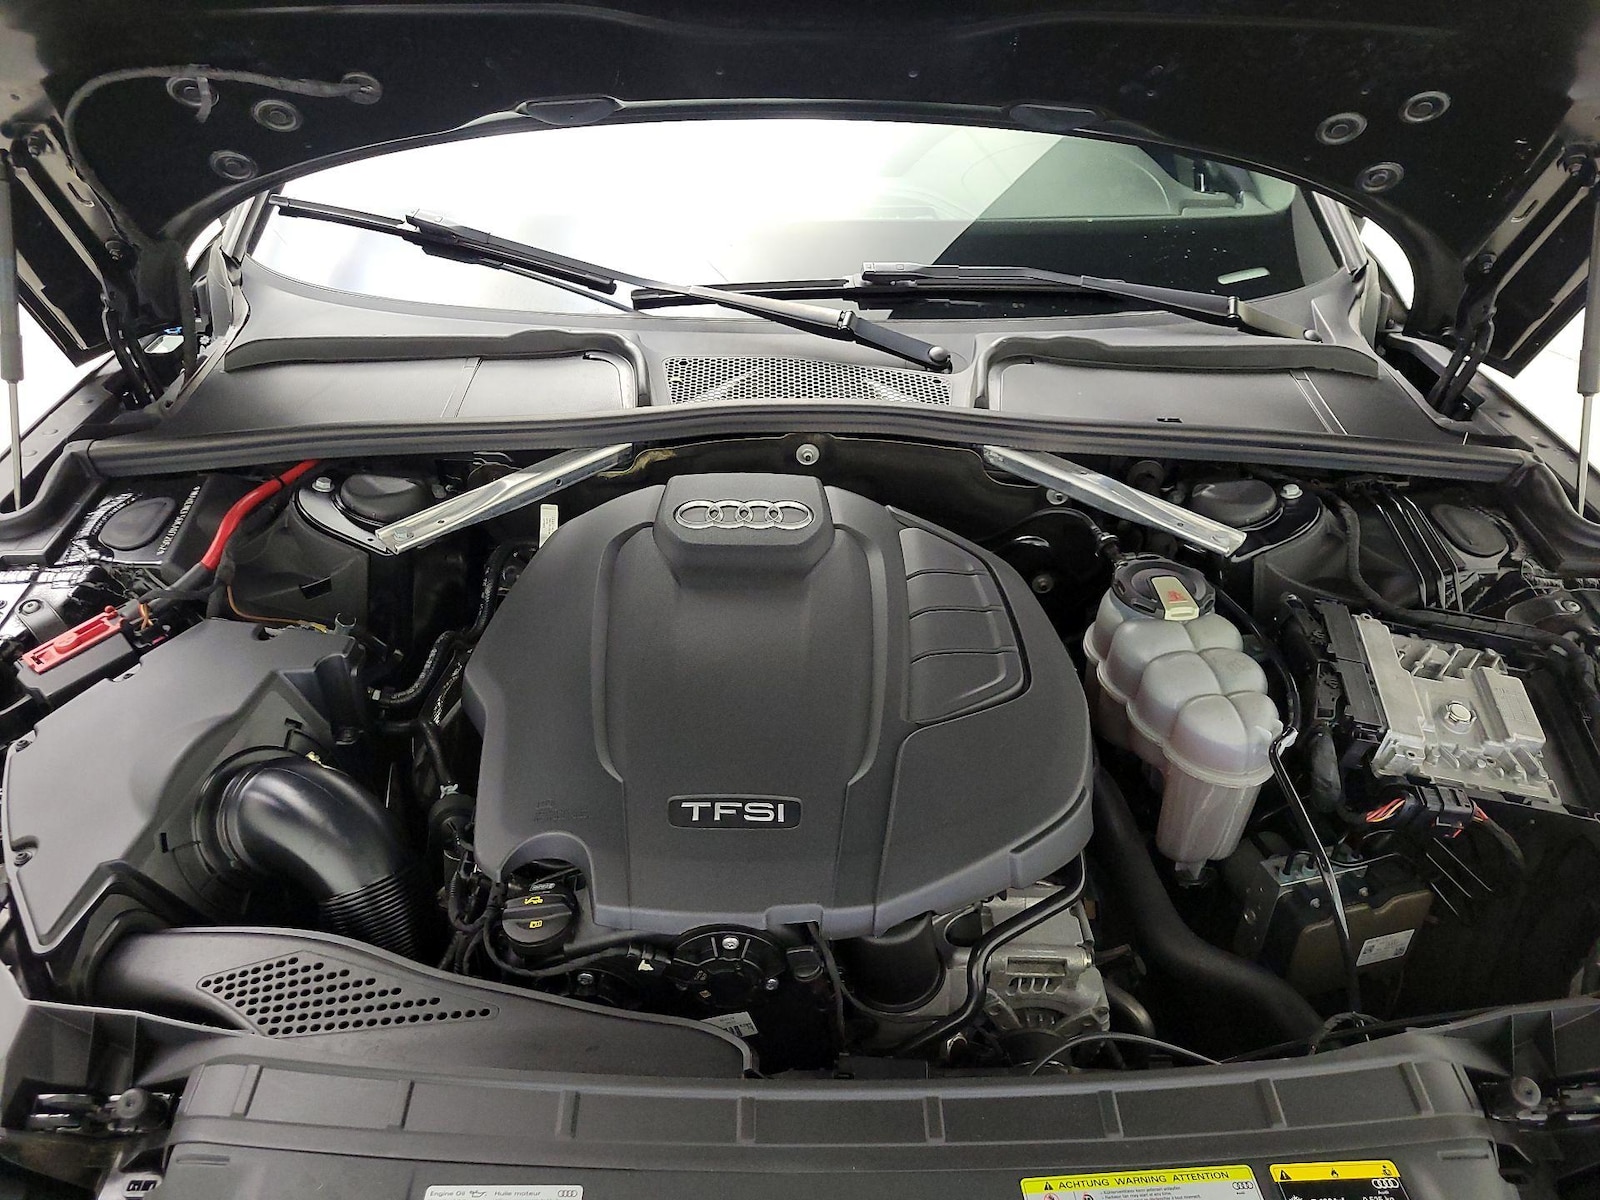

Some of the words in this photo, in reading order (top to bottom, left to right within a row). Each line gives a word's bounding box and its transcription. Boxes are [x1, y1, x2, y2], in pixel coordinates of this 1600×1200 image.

[681, 802, 785, 823] TFSI
[1058, 1178, 1110, 1190] ACHTUNG
[1114, 1174, 1167, 1185] WARNING
[1172, 1171, 1230, 1182] ATTENTION
